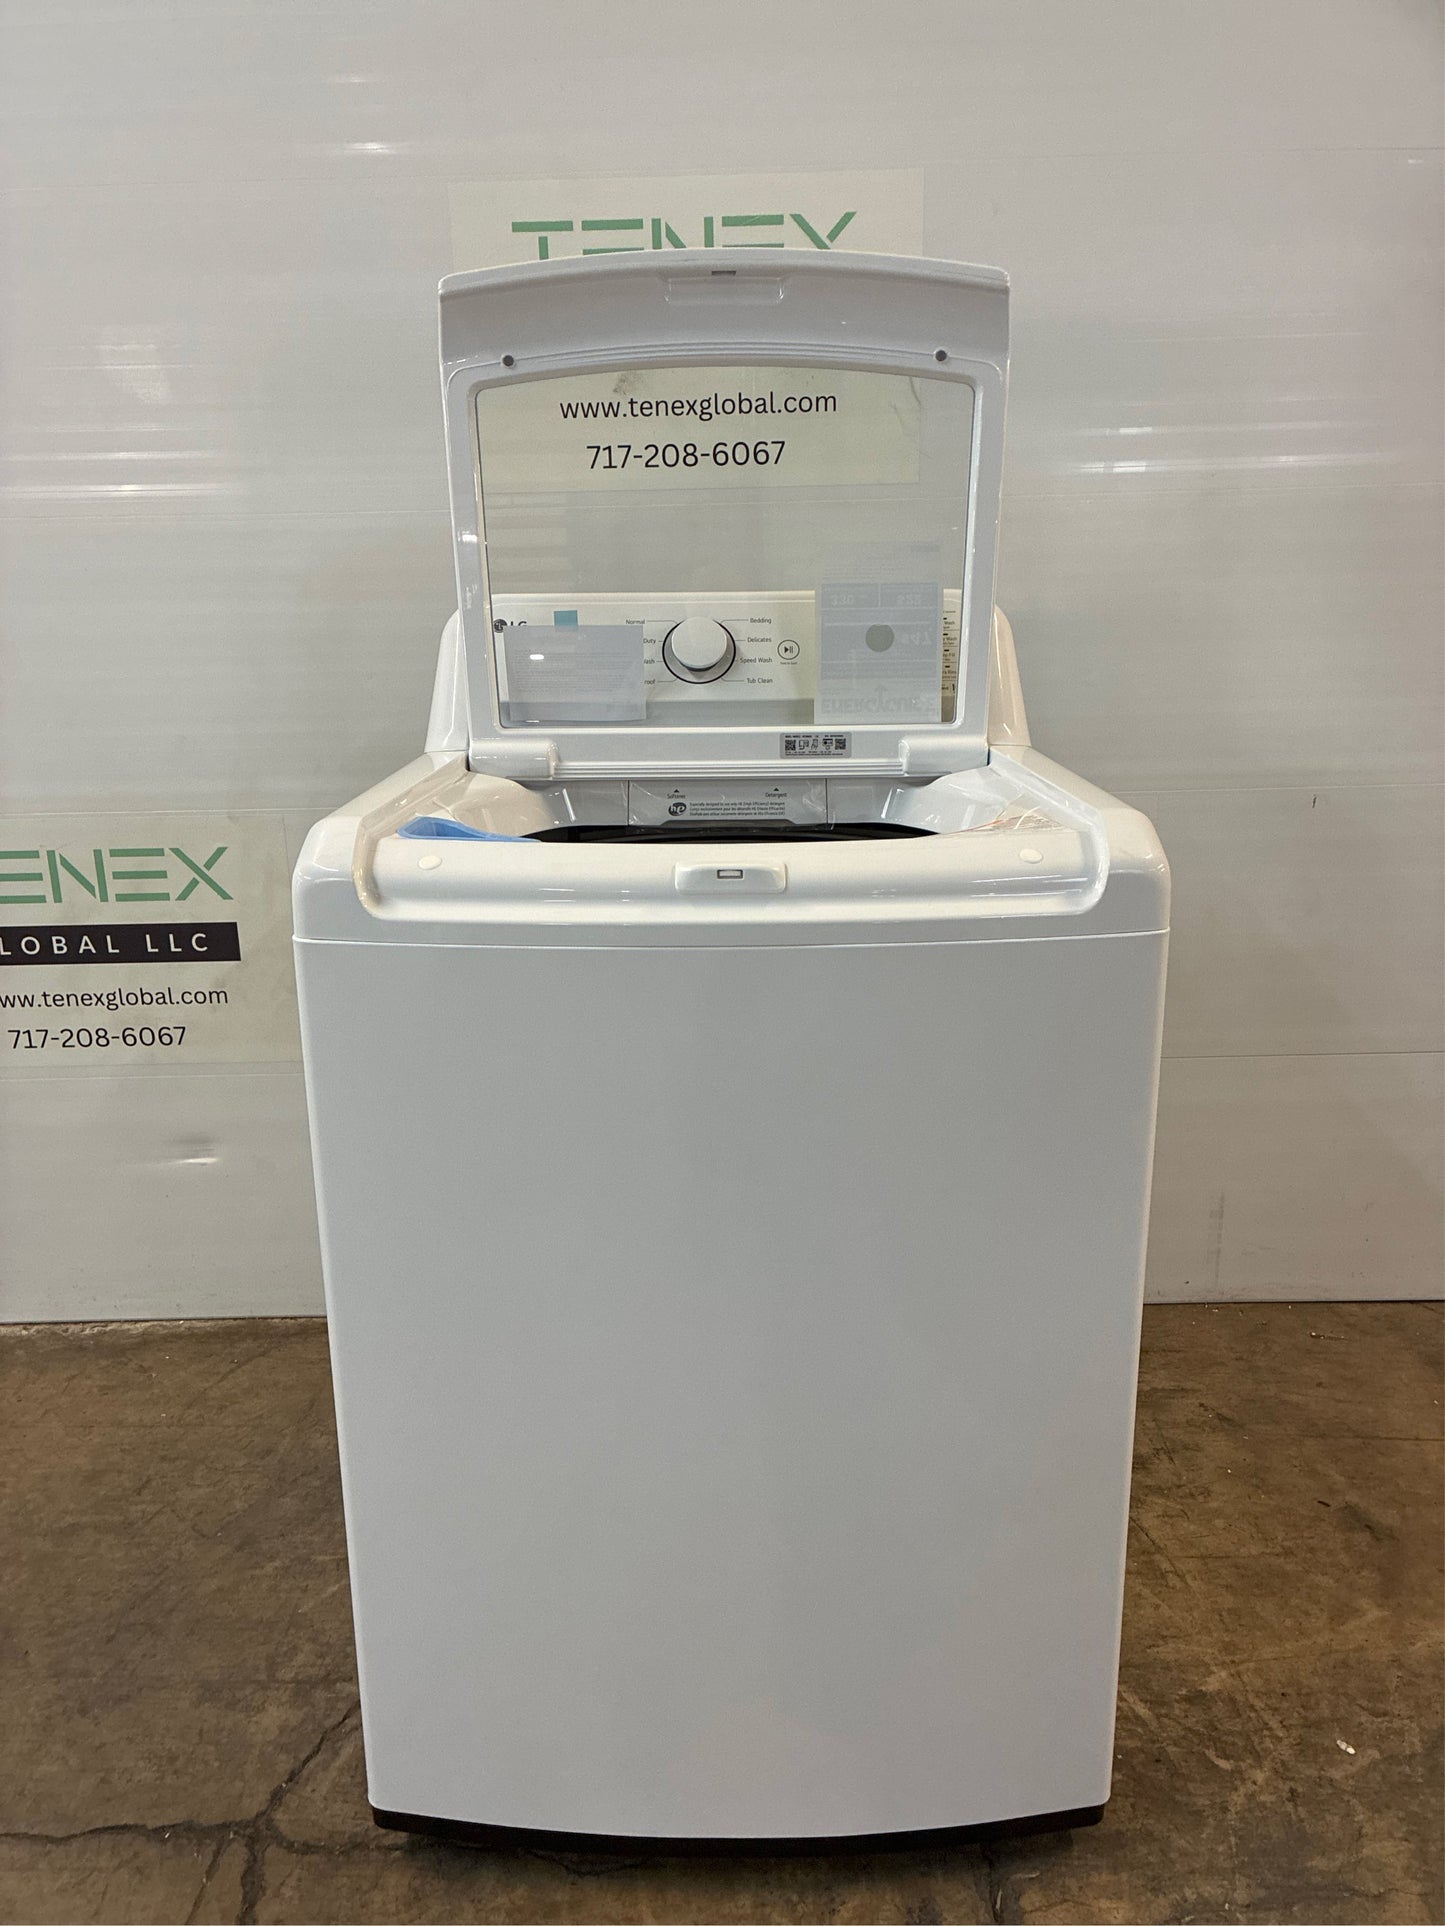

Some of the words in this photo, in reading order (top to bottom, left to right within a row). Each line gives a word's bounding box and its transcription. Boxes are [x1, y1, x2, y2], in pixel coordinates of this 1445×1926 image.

[511, 211, 857, 261] TENEX
[559, 391, 838, 421] www.tenexglobal.com
[586, 440, 787, 470] 717-208-6067
[749, 617, 772, 625] Bedding
[0, 847, 233, 903] ENEX
[0, 934, 120, 956] LOBAL
[145, 933, 208, 953] LLC
[0, 987, 228, 1011] ww.tenexglobal.com
[7, 1026, 187, 1049] 717-208-6067
